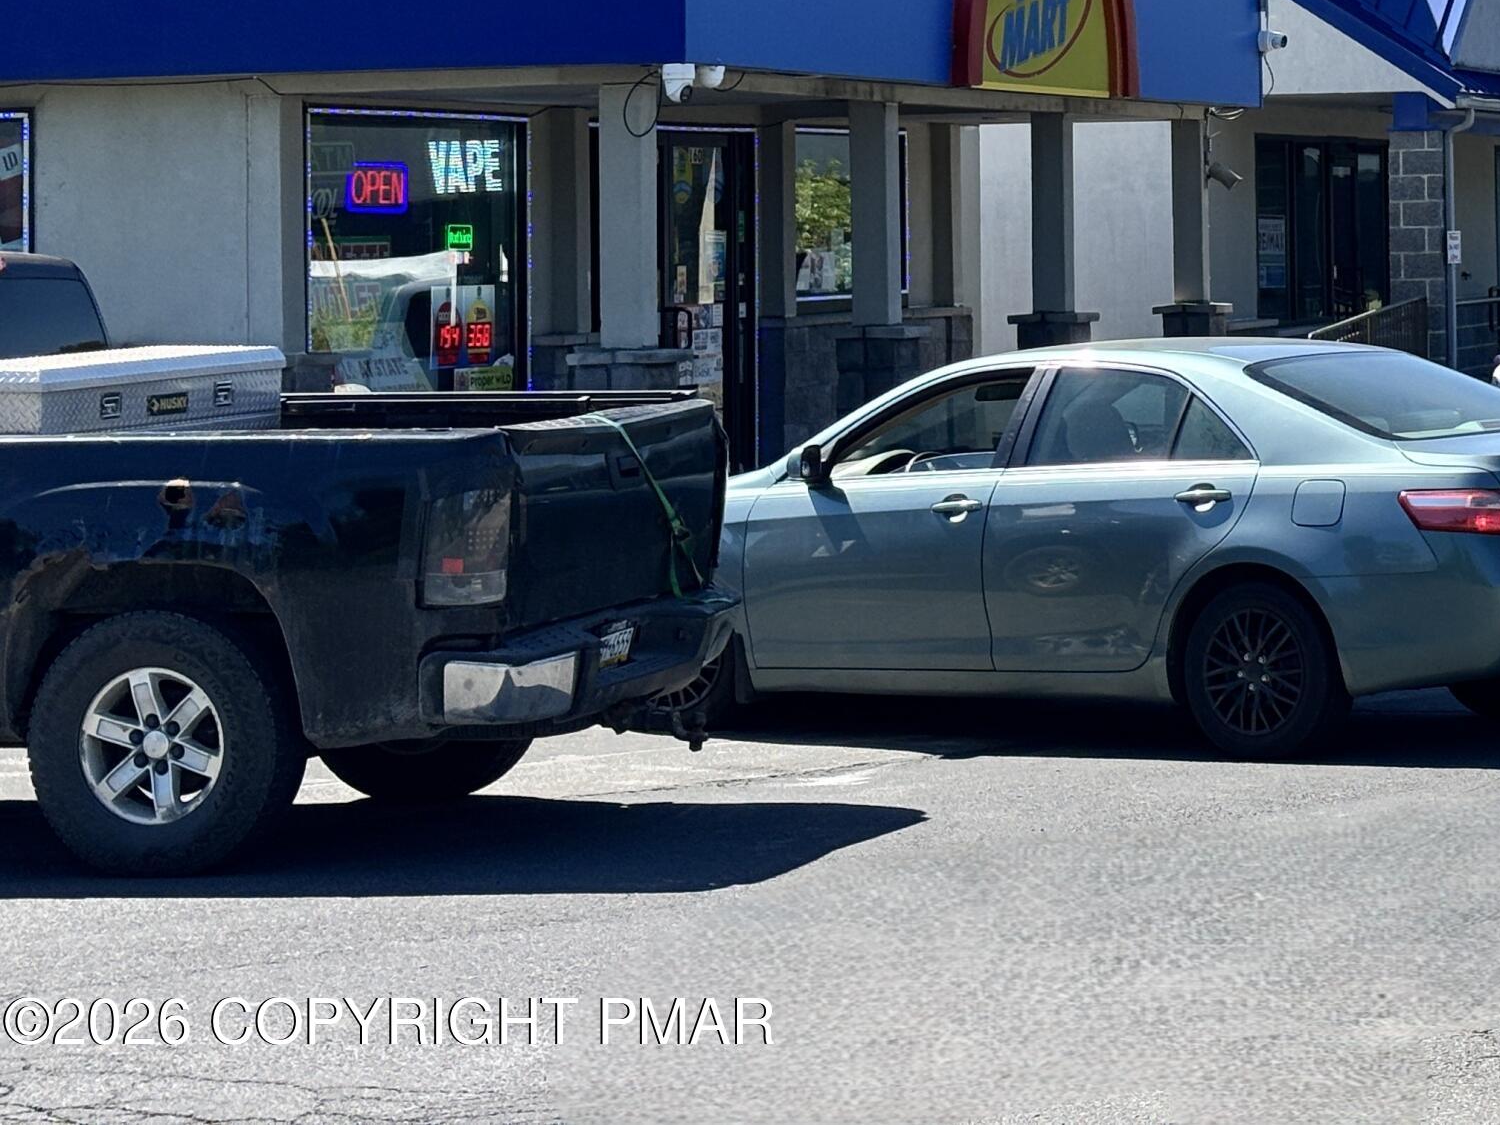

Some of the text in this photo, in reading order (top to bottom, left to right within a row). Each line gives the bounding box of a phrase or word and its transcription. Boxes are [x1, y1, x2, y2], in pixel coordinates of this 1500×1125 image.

[428, 139, 503, 194] VAPE
[352, 171, 404, 203] OPEN
[160, 396, 187, 410] HUSKY
